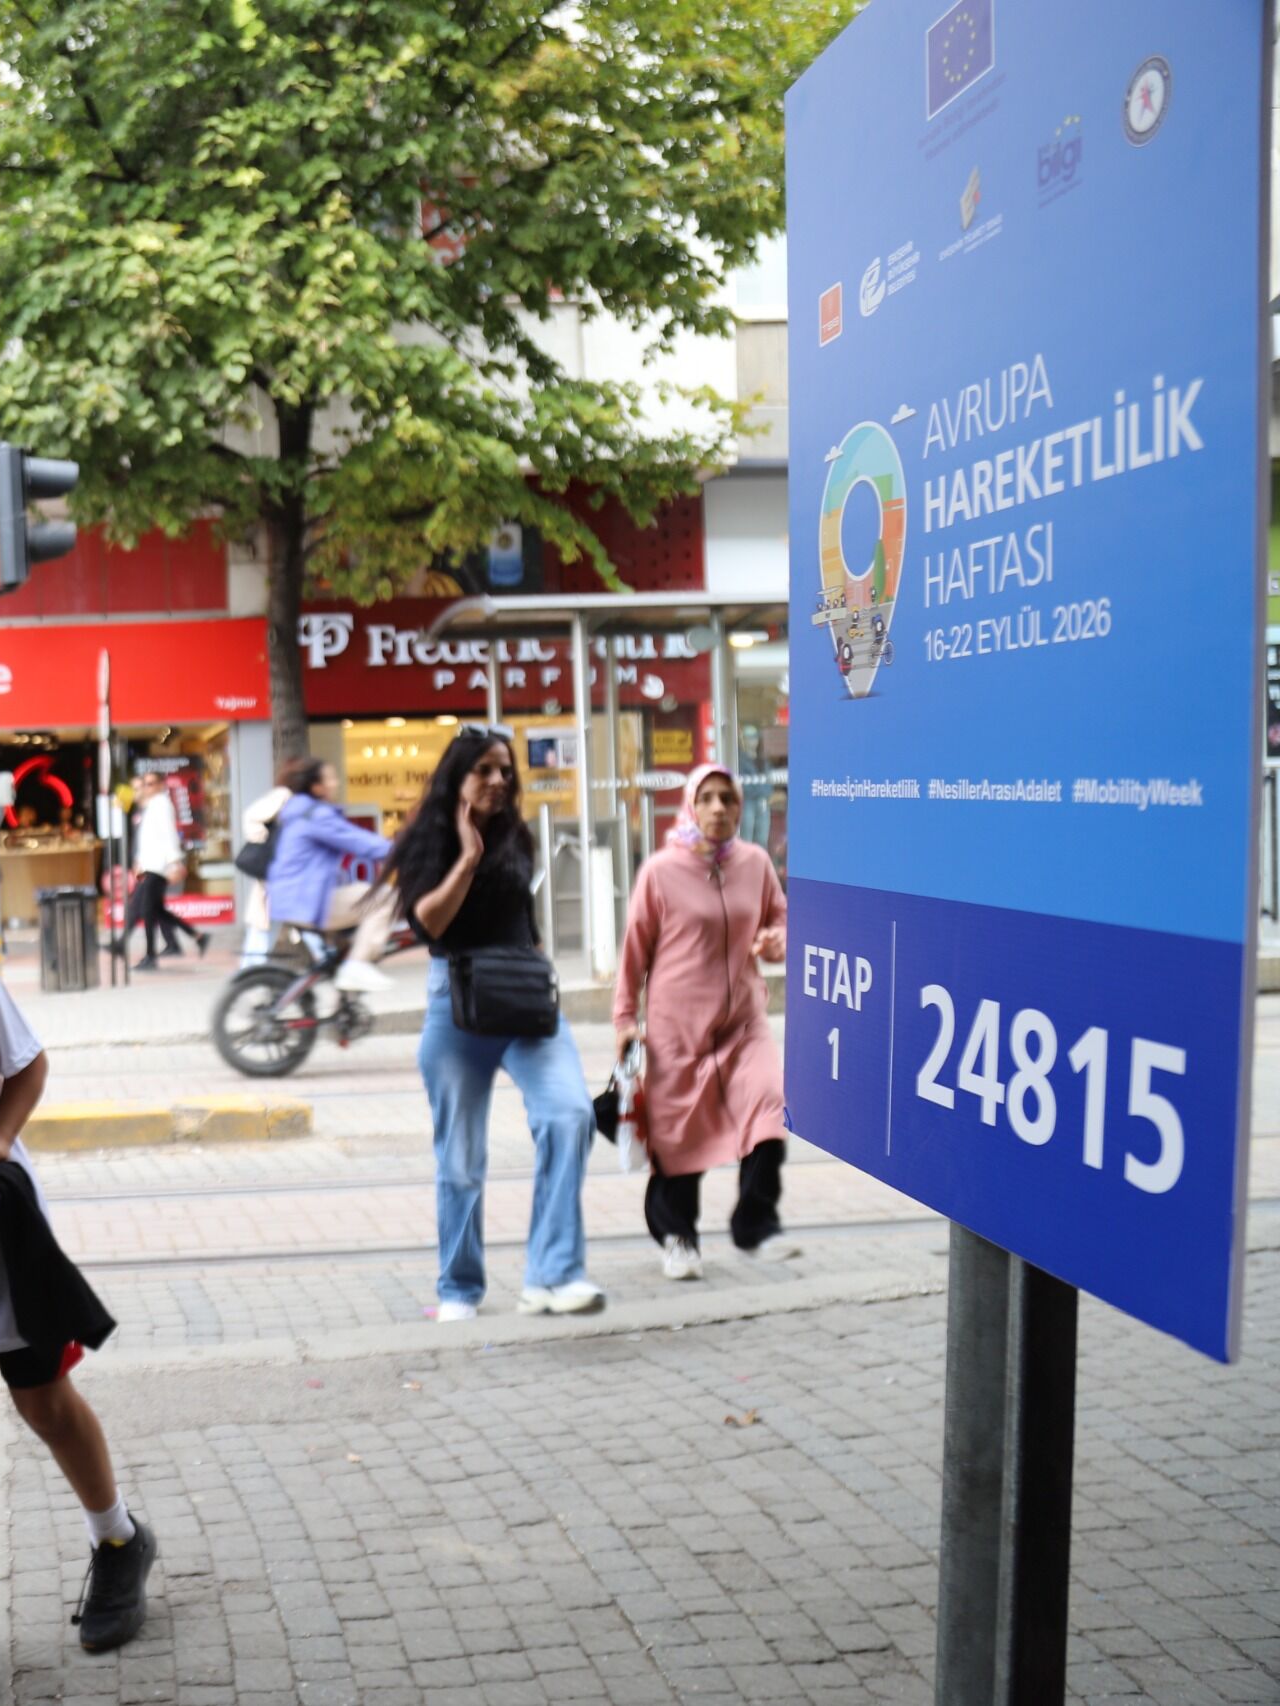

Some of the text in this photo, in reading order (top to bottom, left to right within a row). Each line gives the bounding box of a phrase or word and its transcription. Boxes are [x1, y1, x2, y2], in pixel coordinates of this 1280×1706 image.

[923, 353, 1054, 459] AVRUPA
[924, 374, 1205, 533] HAREKETLİLİK
[924, 521, 1053, 608] HAFTASI
[924, 597, 1112, 662] 16-22 EYLÜL 2026
[1072, 777, 1204, 811] #MobilityWeek
[803, 944, 872, 1012] ETAP
[827, 1027, 840, 1081] 1
[916, 984, 1187, 1195] 24815
